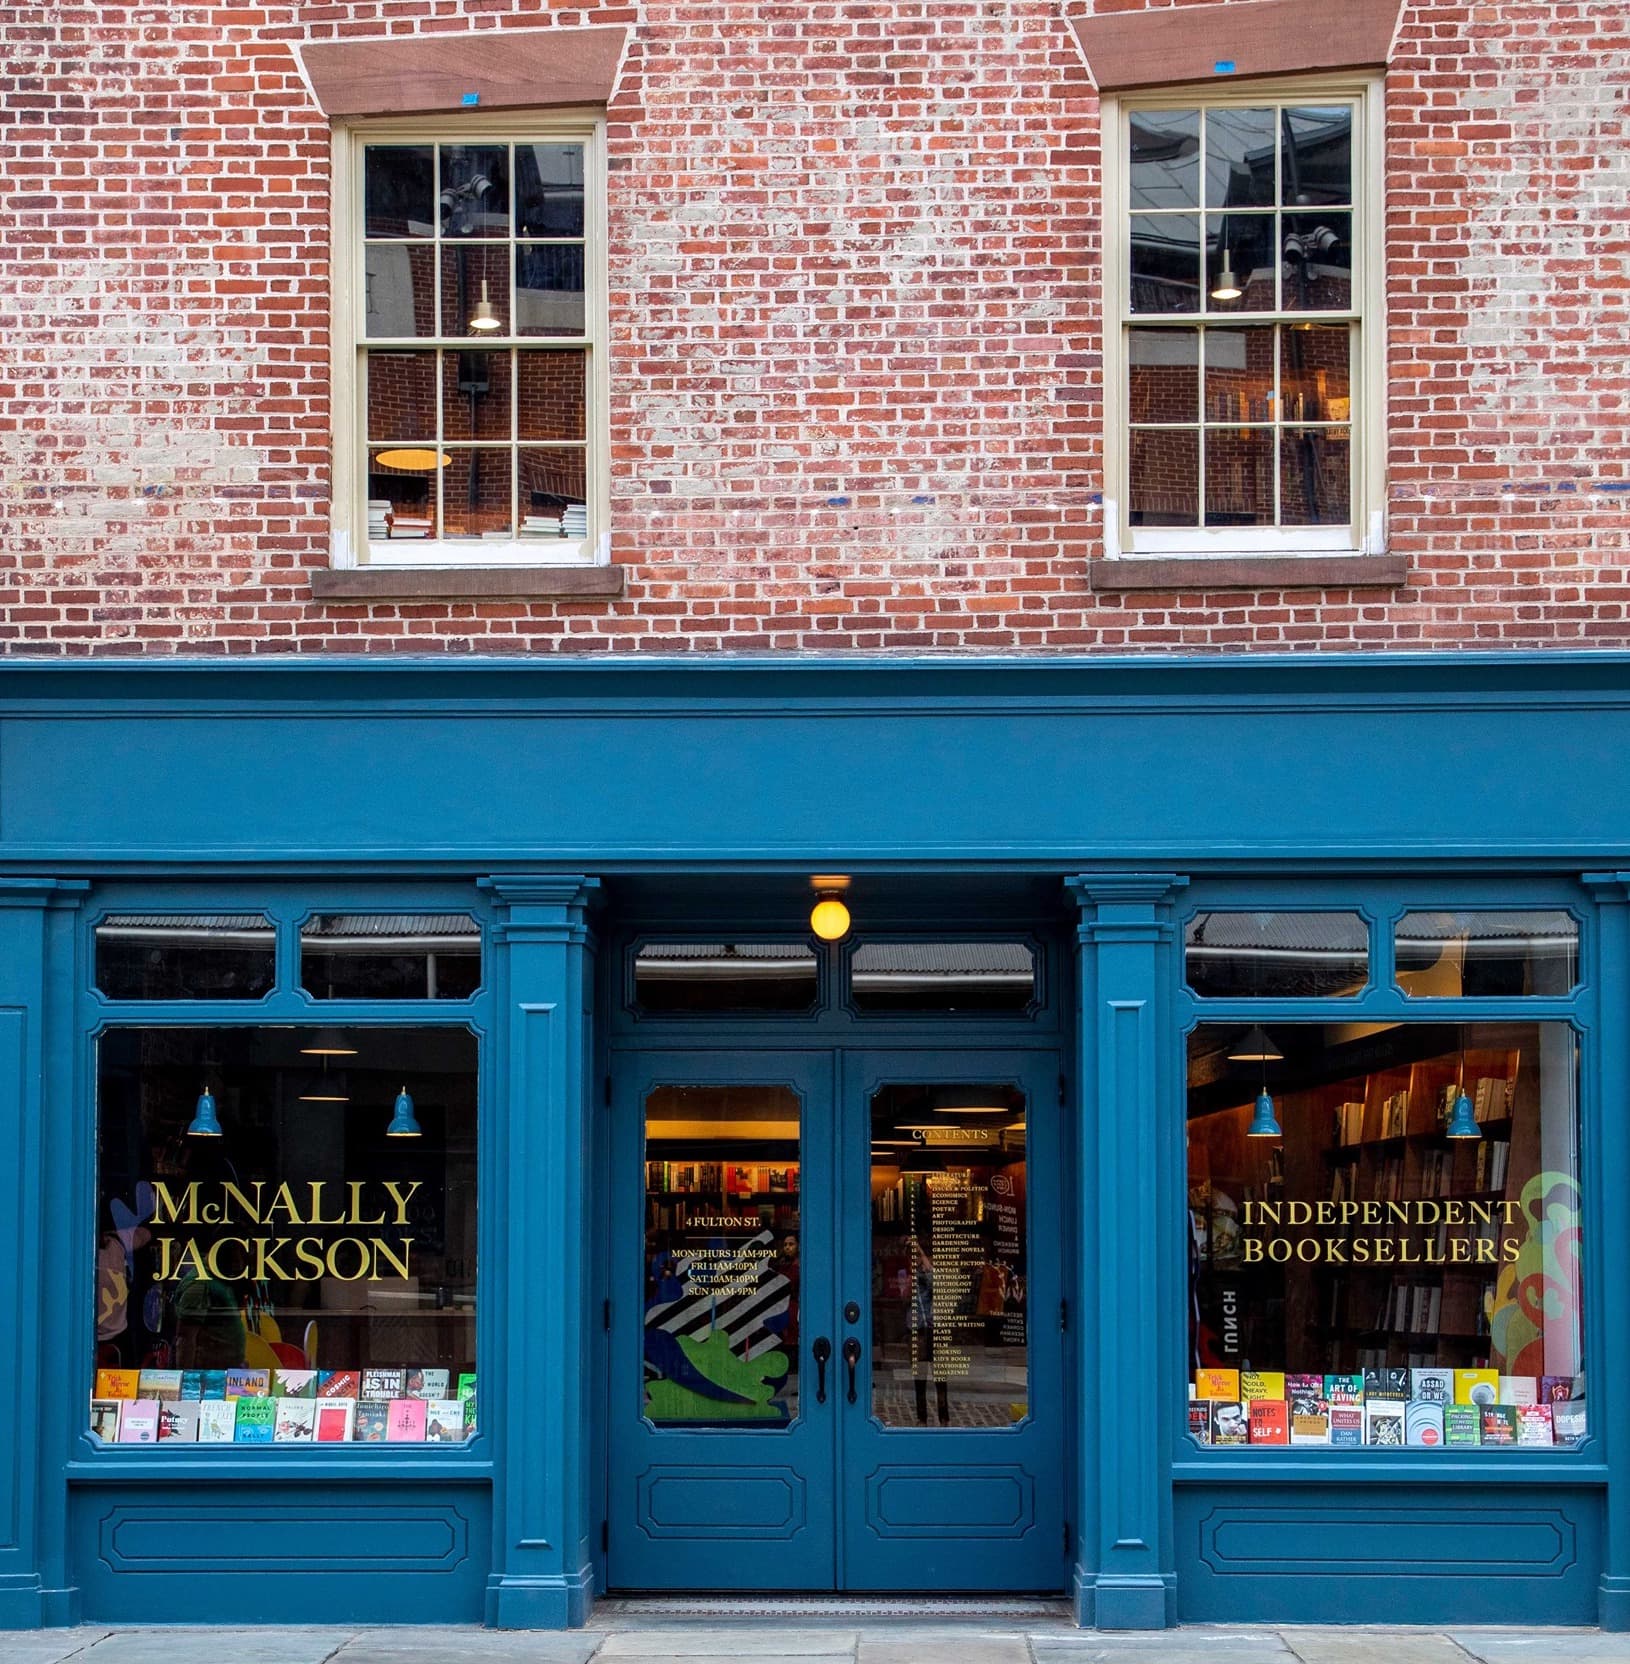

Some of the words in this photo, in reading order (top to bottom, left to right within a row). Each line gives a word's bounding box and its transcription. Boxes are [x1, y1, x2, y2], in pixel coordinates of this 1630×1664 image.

[912, 1129, 989, 1140] CONTENTS
[150, 1181, 424, 1225] McNALLY
[1242, 1200, 1521, 1226] INDEPENDENT
[686, 1217, 692, 1226] 4
[694, 1216, 742, 1227] FULTON
[744, 1216, 761, 1227] ST.
[672, 1249, 731, 1258] MON-THURS
[733, 1249, 777, 1258] 11AM-9PM
[1242, 1238, 1521, 1263] BOOKSELLERS
[153, 1236, 415, 1282] JACKSON
[691, 1262, 707, 1270] FRI
[709, 1262, 758, 1270] 11AM-10PM
[690, 1275, 709, 1283] SAT
[710, 1275, 759, 1283] 10AM-10PM
[688, 1287, 709, 1296] SUN
[711, 1287, 757, 1296] 10AM-9PM
[228, 1376, 264, 1387] INLAND
[326, 1374, 351, 1397] COSMIC
[366, 1378, 380, 1389] IS
[384, 1378, 400, 1389] IN
[1327, 1394, 1360, 1402] LEAVING
[1252, 1408, 1276, 1417] NOTES
[1254, 1419, 1262, 1427] TO
[1253, 1427, 1272, 1437] SELF
